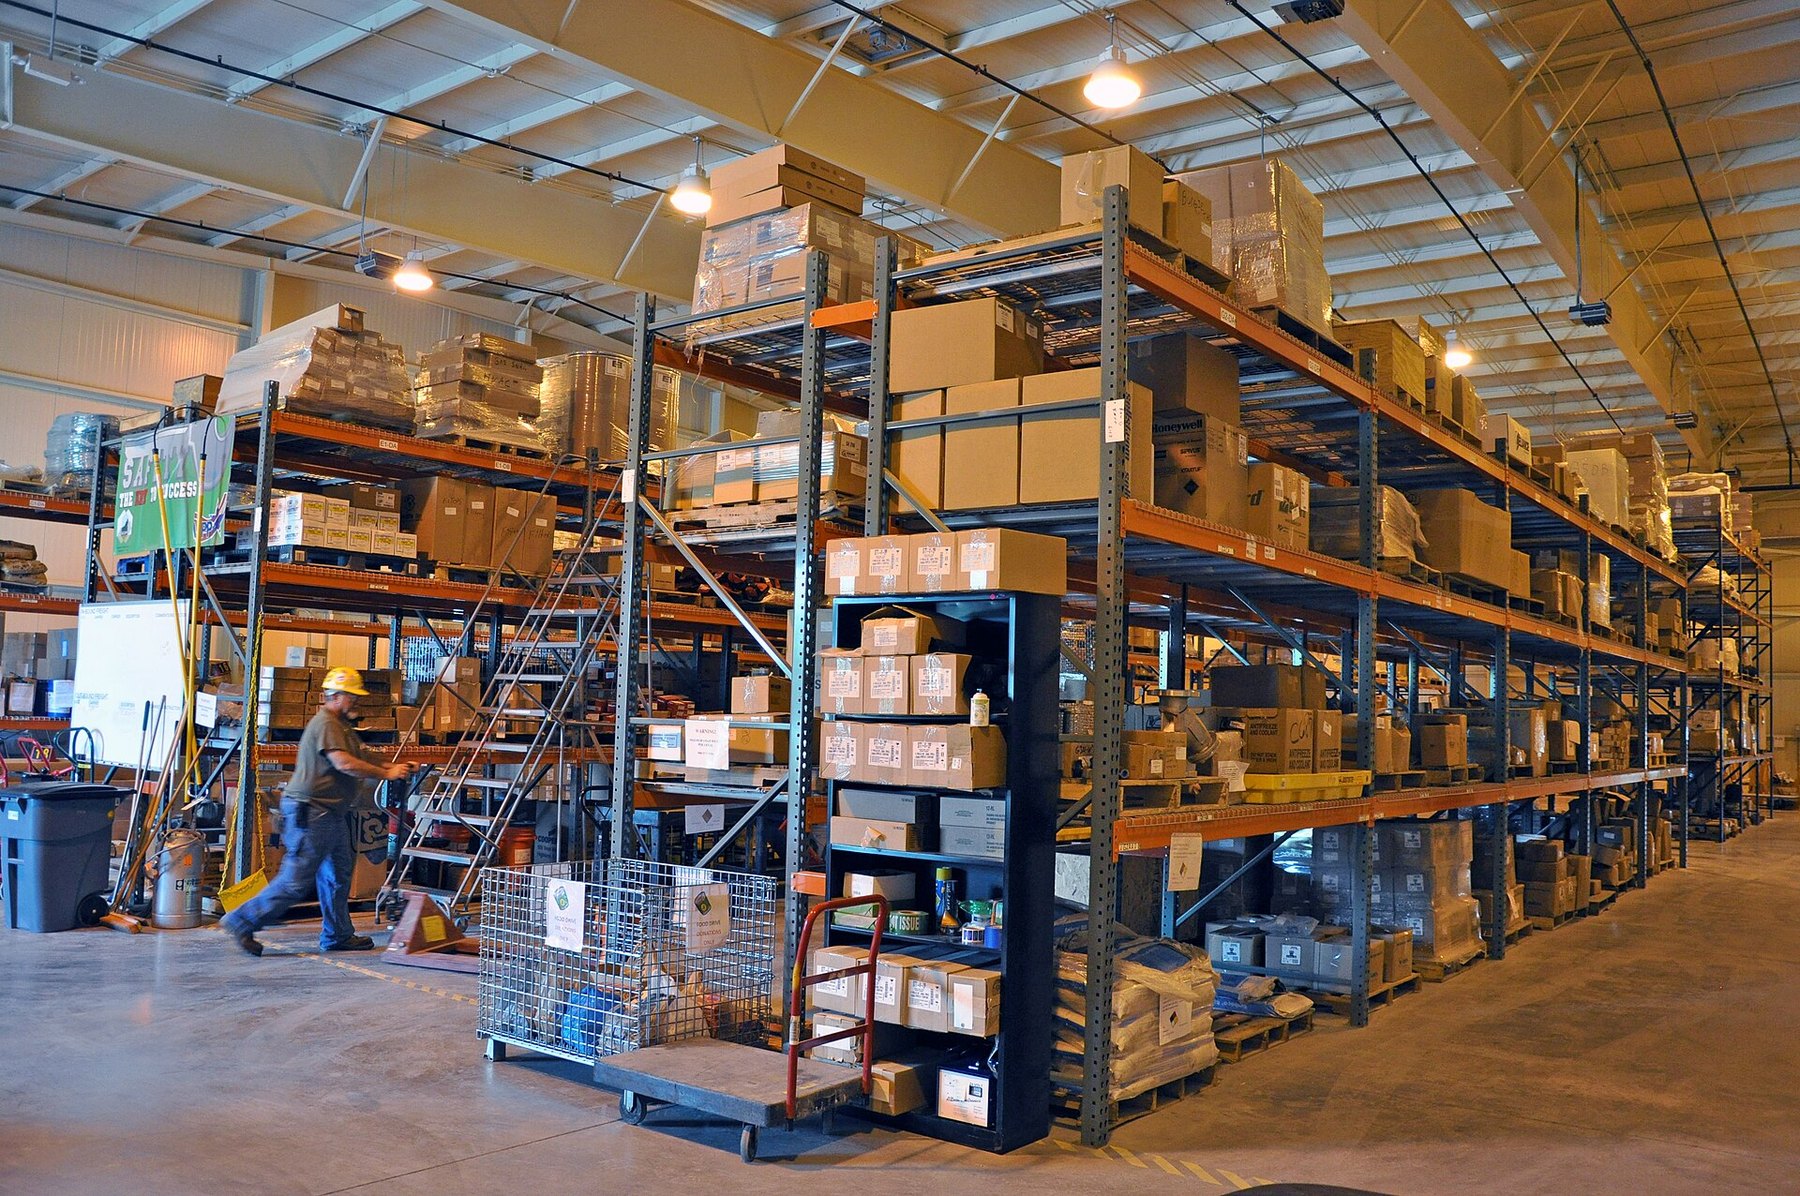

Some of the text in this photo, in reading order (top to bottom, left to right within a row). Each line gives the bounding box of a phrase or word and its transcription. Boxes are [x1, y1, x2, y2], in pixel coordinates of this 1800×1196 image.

[120, 491, 134, 508] THE
[162, 481, 198, 499] UCCESS
[899, 916, 920, 931] ISSUE
